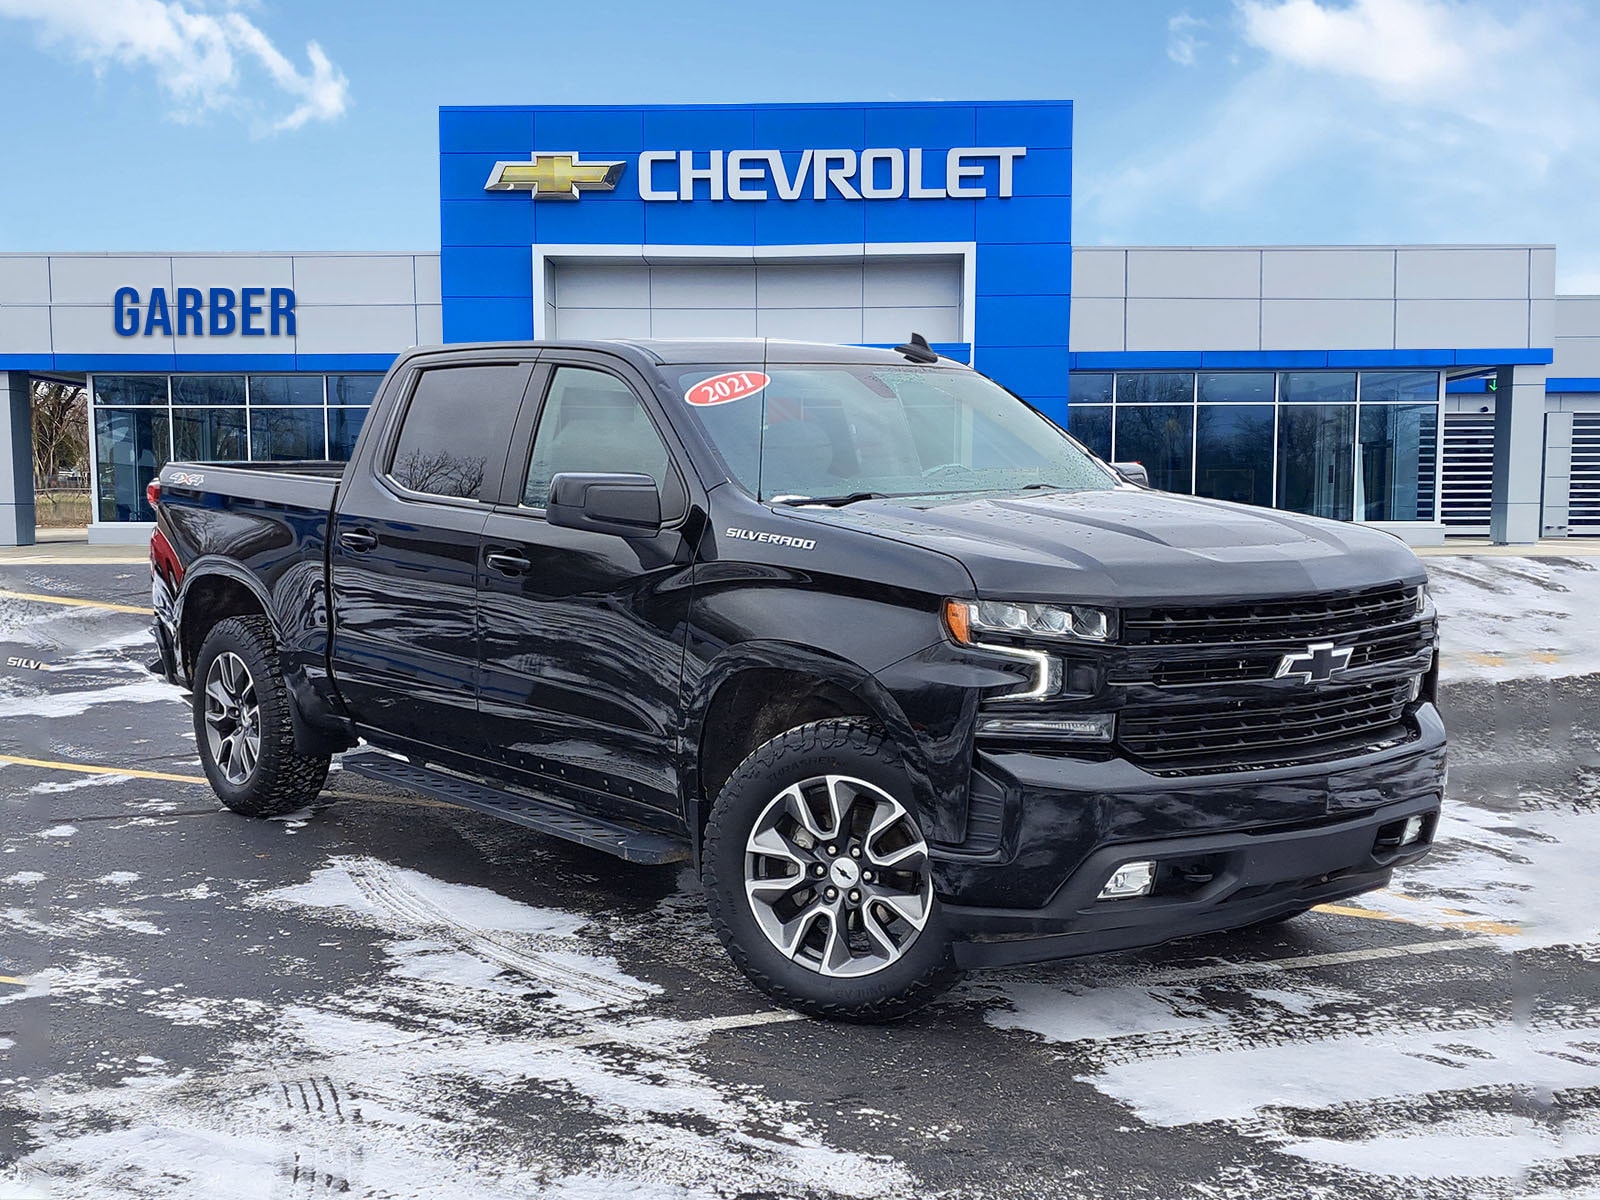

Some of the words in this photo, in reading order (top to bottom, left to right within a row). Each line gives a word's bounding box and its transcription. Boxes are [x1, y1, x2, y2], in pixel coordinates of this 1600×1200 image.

[637, 147, 1026, 201] CHEVROLET
[114, 287, 296, 336] GARBER
[701, 373, 755, 402] 2021
[726, 528, 816, 550] SILVERADO
